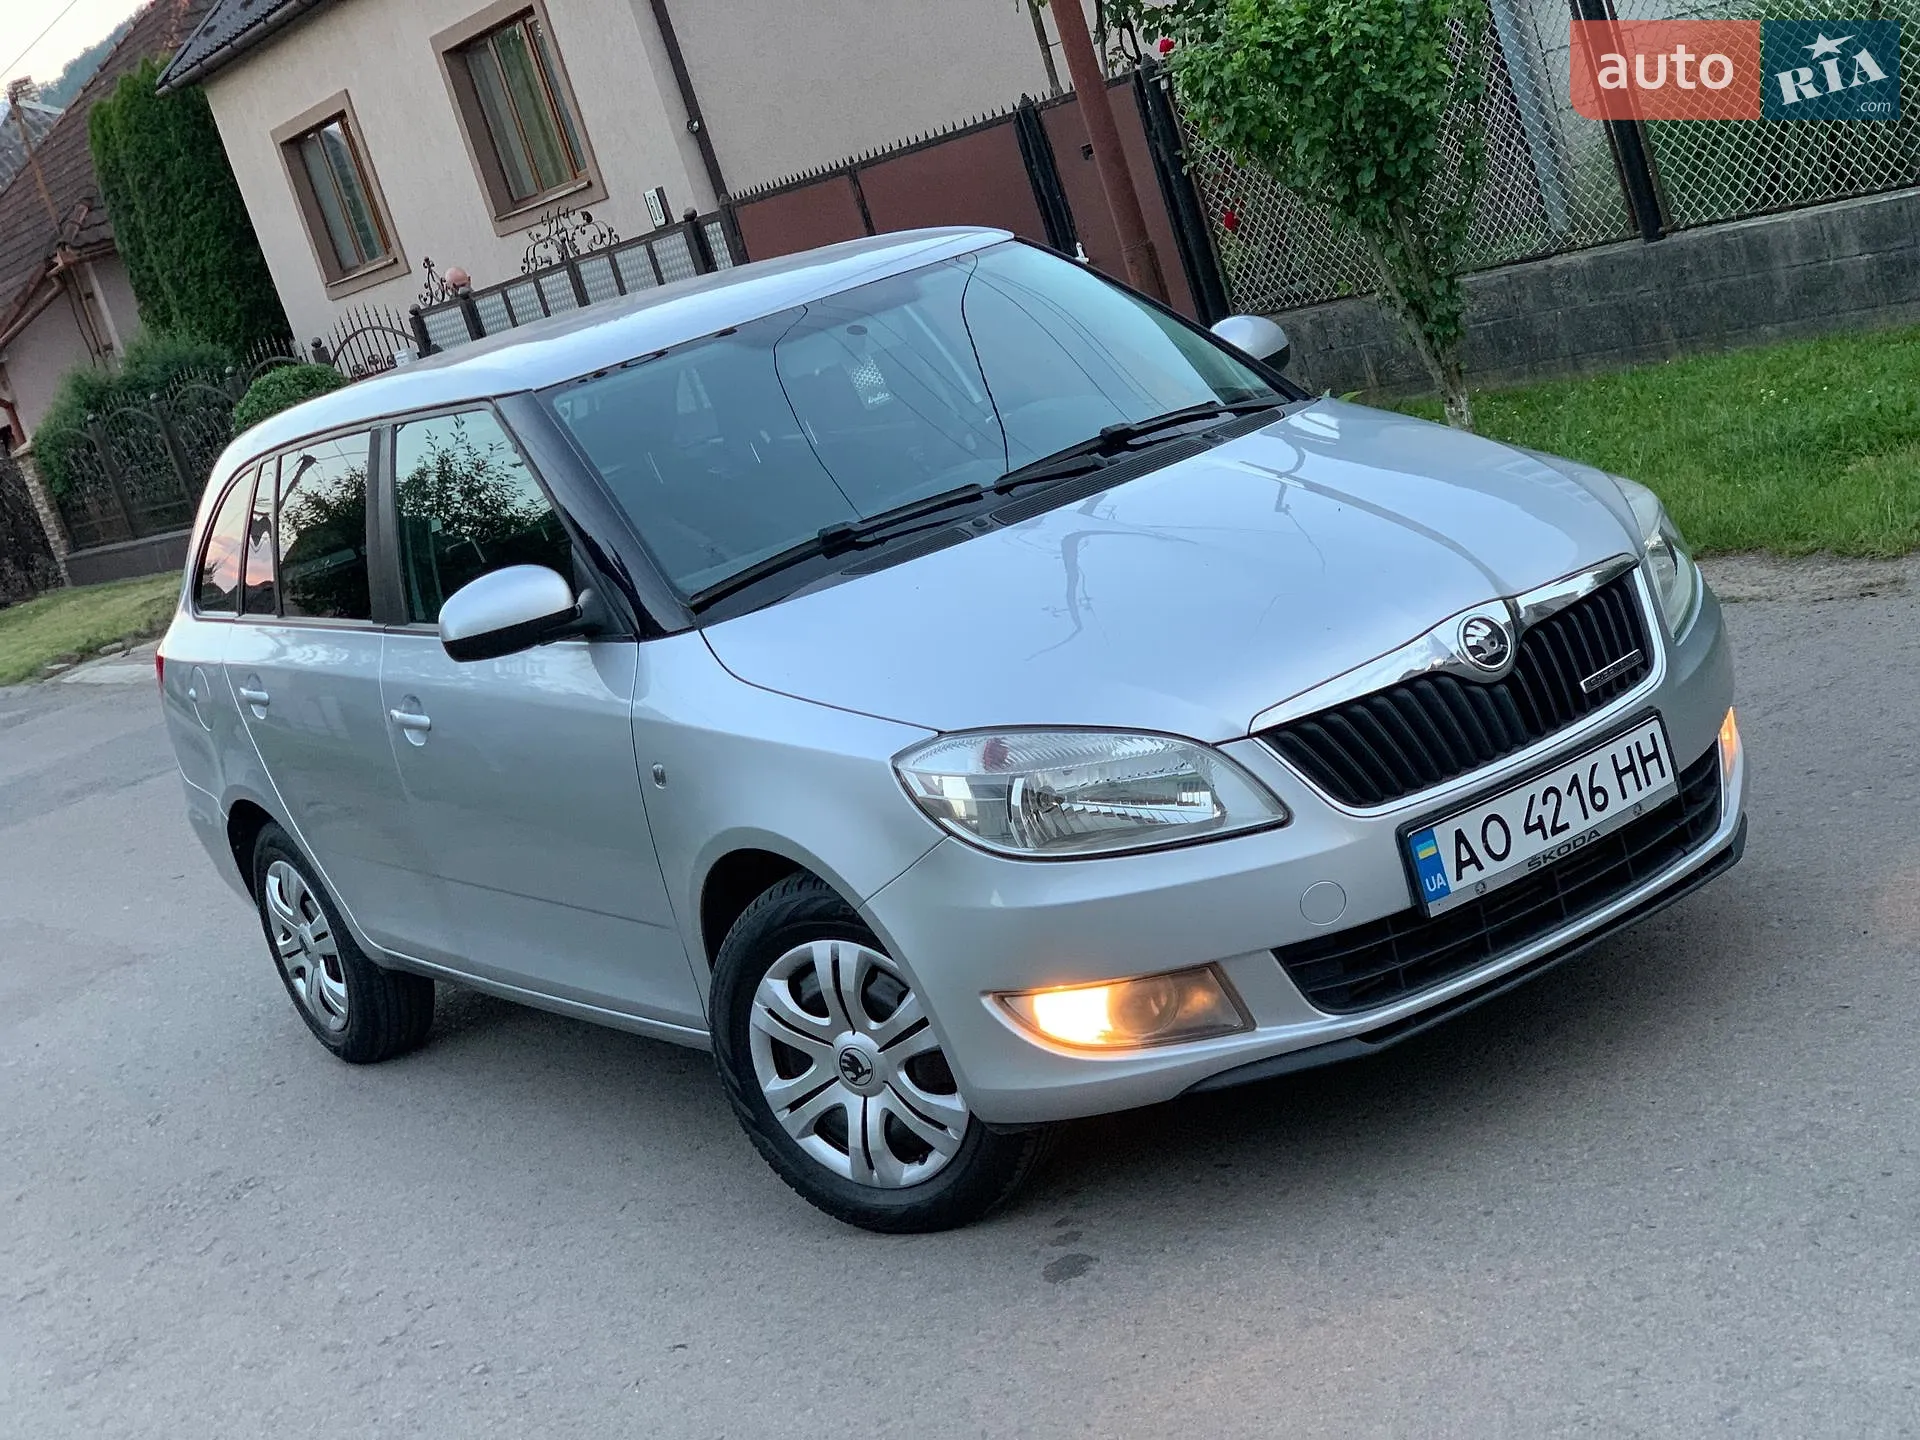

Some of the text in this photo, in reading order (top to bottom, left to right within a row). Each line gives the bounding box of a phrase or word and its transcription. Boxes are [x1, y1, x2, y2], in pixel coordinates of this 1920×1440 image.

[1454, 732, 1666, 881] AO 4216 HH
[1425, 873, 1447, 892] UA
